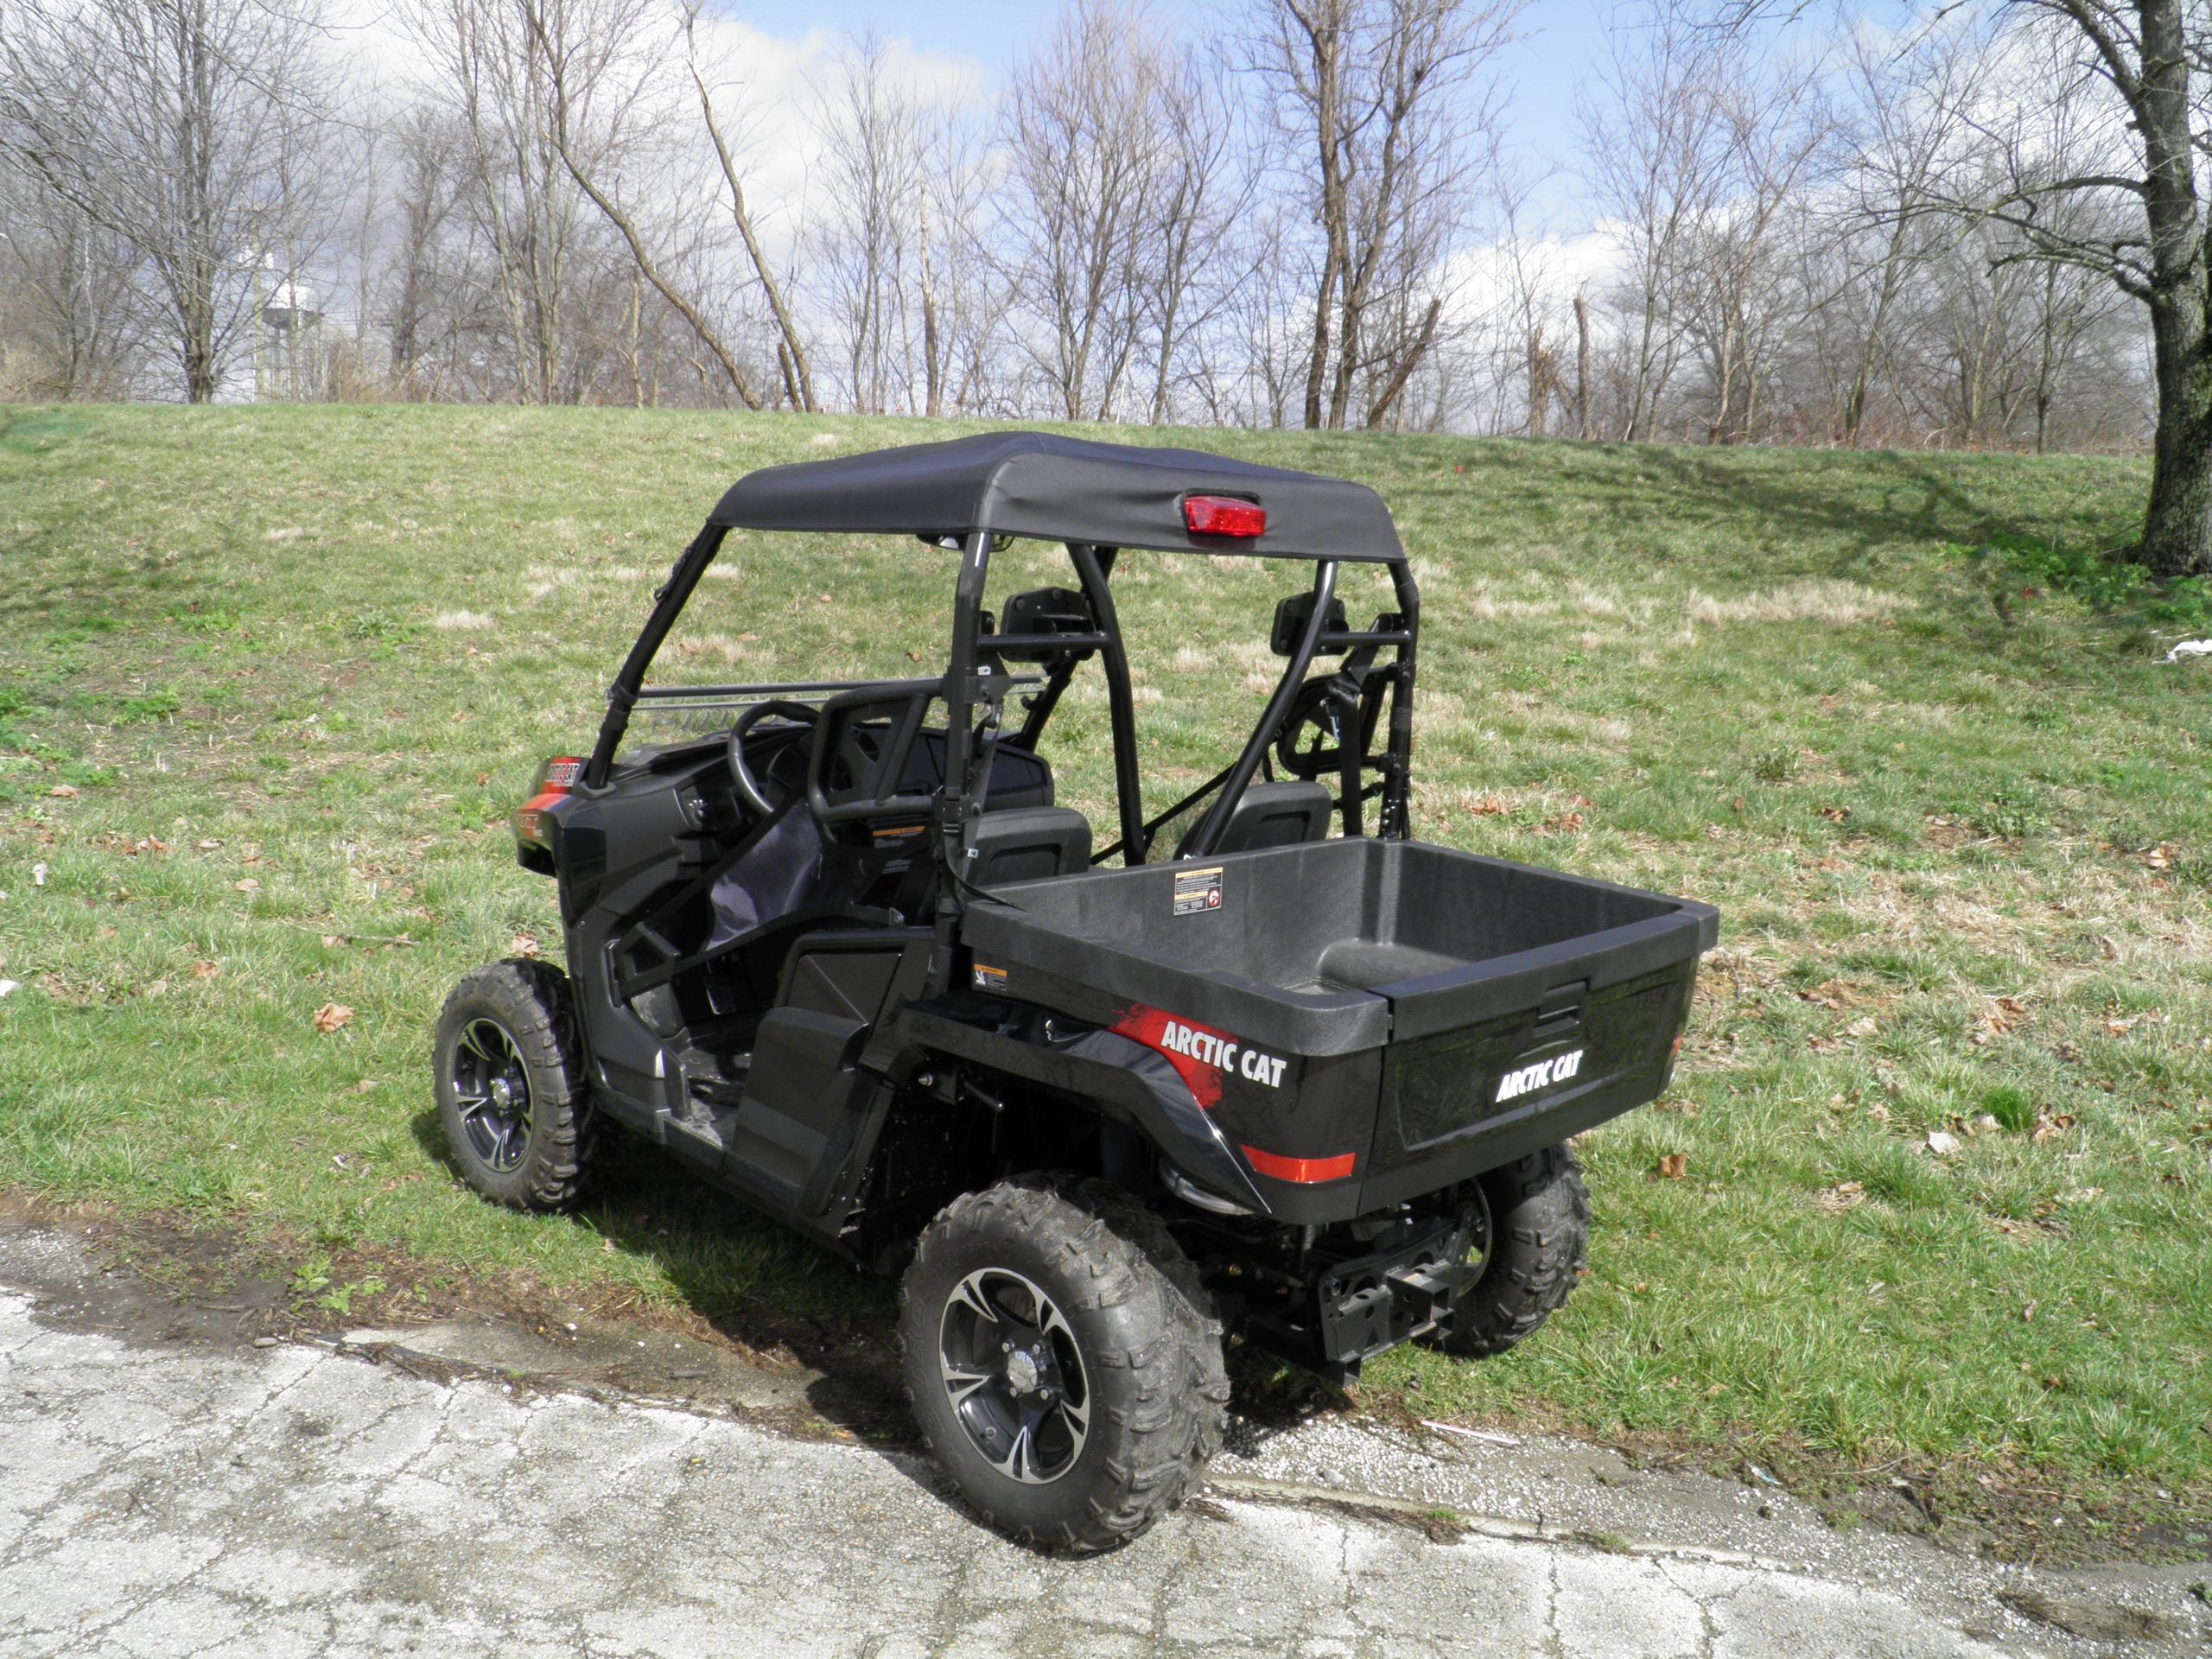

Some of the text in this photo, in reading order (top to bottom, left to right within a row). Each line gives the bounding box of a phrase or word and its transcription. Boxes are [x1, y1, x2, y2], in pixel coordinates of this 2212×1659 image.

[1160, 1020, 1287, 1088] ARCTIC CAT
[1495, 1049, 1584, 1103] ARCTIC CAT
